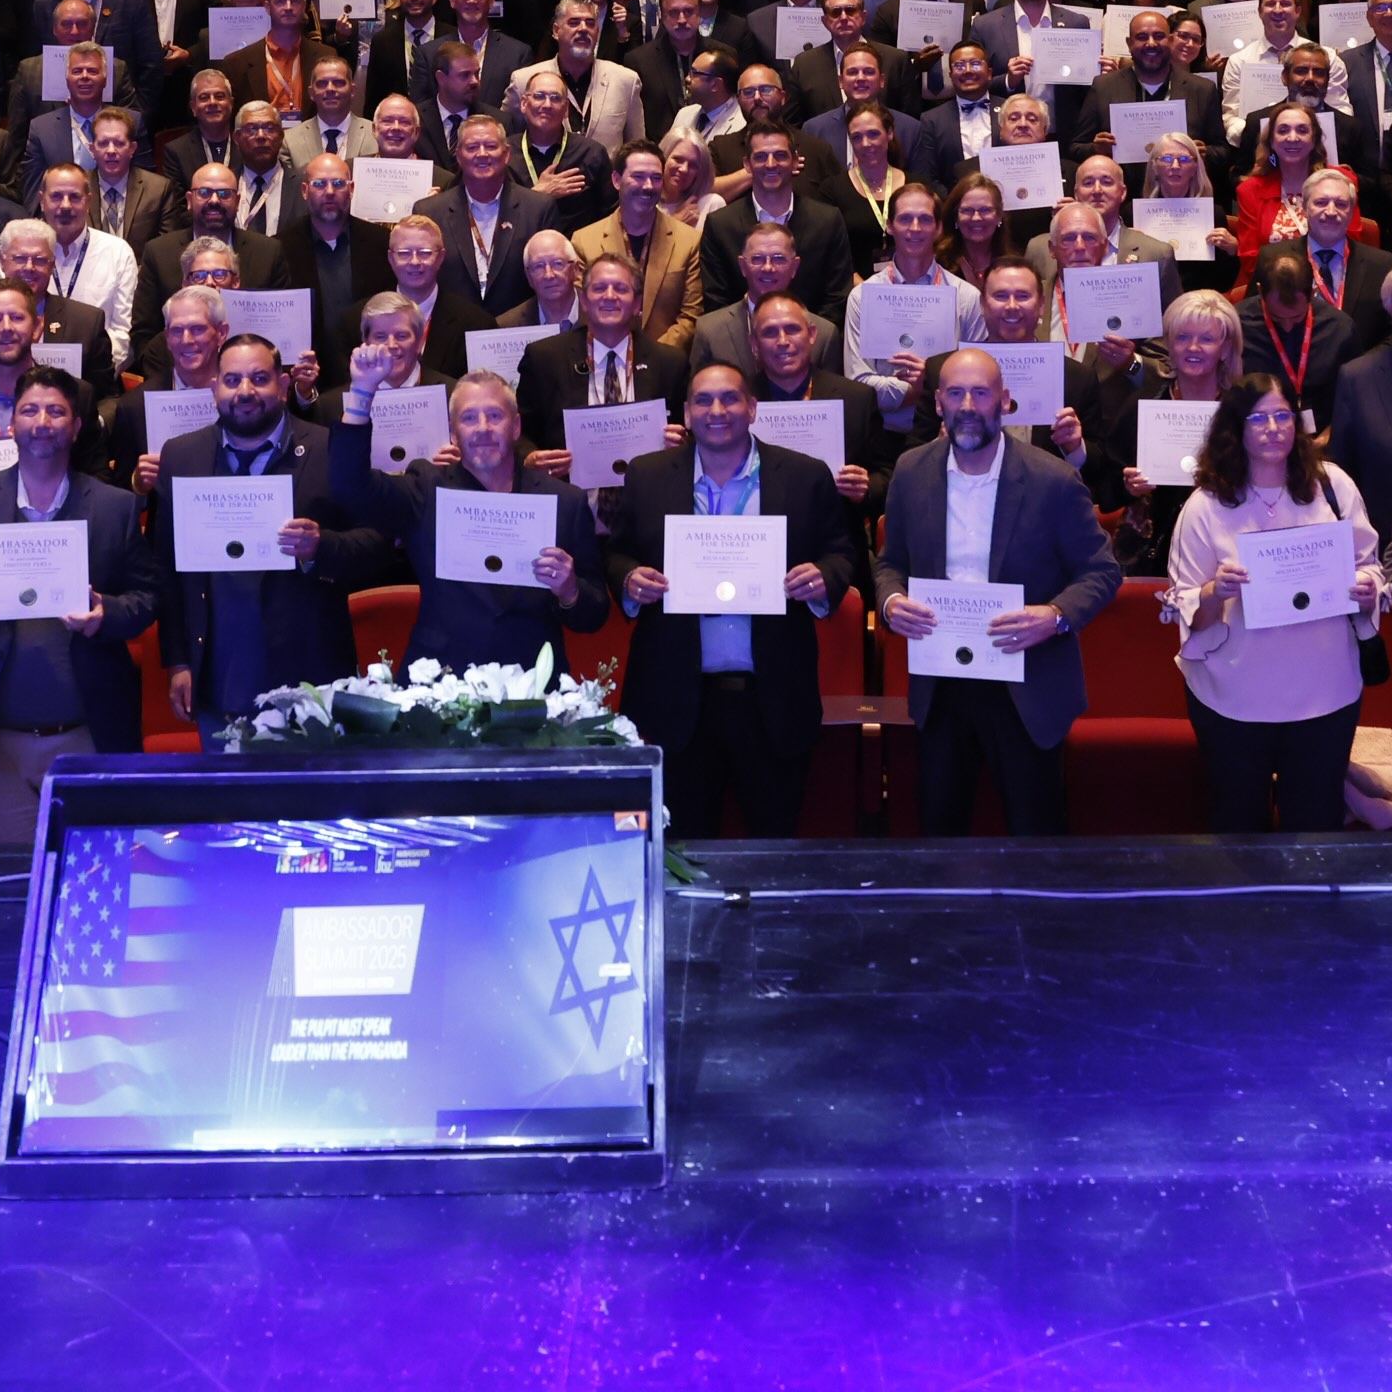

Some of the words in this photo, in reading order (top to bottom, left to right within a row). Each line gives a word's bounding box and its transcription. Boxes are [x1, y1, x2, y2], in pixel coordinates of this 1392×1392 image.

[580, 414, 649, 430] AMBASSADOR
[757, 413, 828, 423] AMBASSADOR
[611, 423, 634, 431] ISRAEL
[193, 493, 275, 503] AMBASSADOR
[453, 506, 536, 520] AMBASSADOR
[470, 514, 484, 522] FOR
[489, 516, 519, 525] ISRAEL
[685, 532, 769, 542] AMBASSADOR
[2, 547, 17, 555] FOR
[22, 546, 52, 554] ISRAEL
[1257, 539, 1334, 558] AMBASSADOR
[1291, 551, 1319, 559] ISRAEL
[925, 597, 1003, 608] AMBASSADOR
[303, 914, 413, 941] AMBASSADOR
[303, 947, 367, 972] SUMMIT
[369, 945, 407, 969] 2025
[291, 1019, 307, 1037] THE
[308, 1018, 337, 1037] PULPIT
[337, 1018, 363, 1036] MUST
[363, 1017, 392, 1036] SPEAK
[307, 1042, 331, 1061] THAN
[331, 1042, 349, 1060] THE
[349, 1040, 408, 1060] PROPAGANDA
